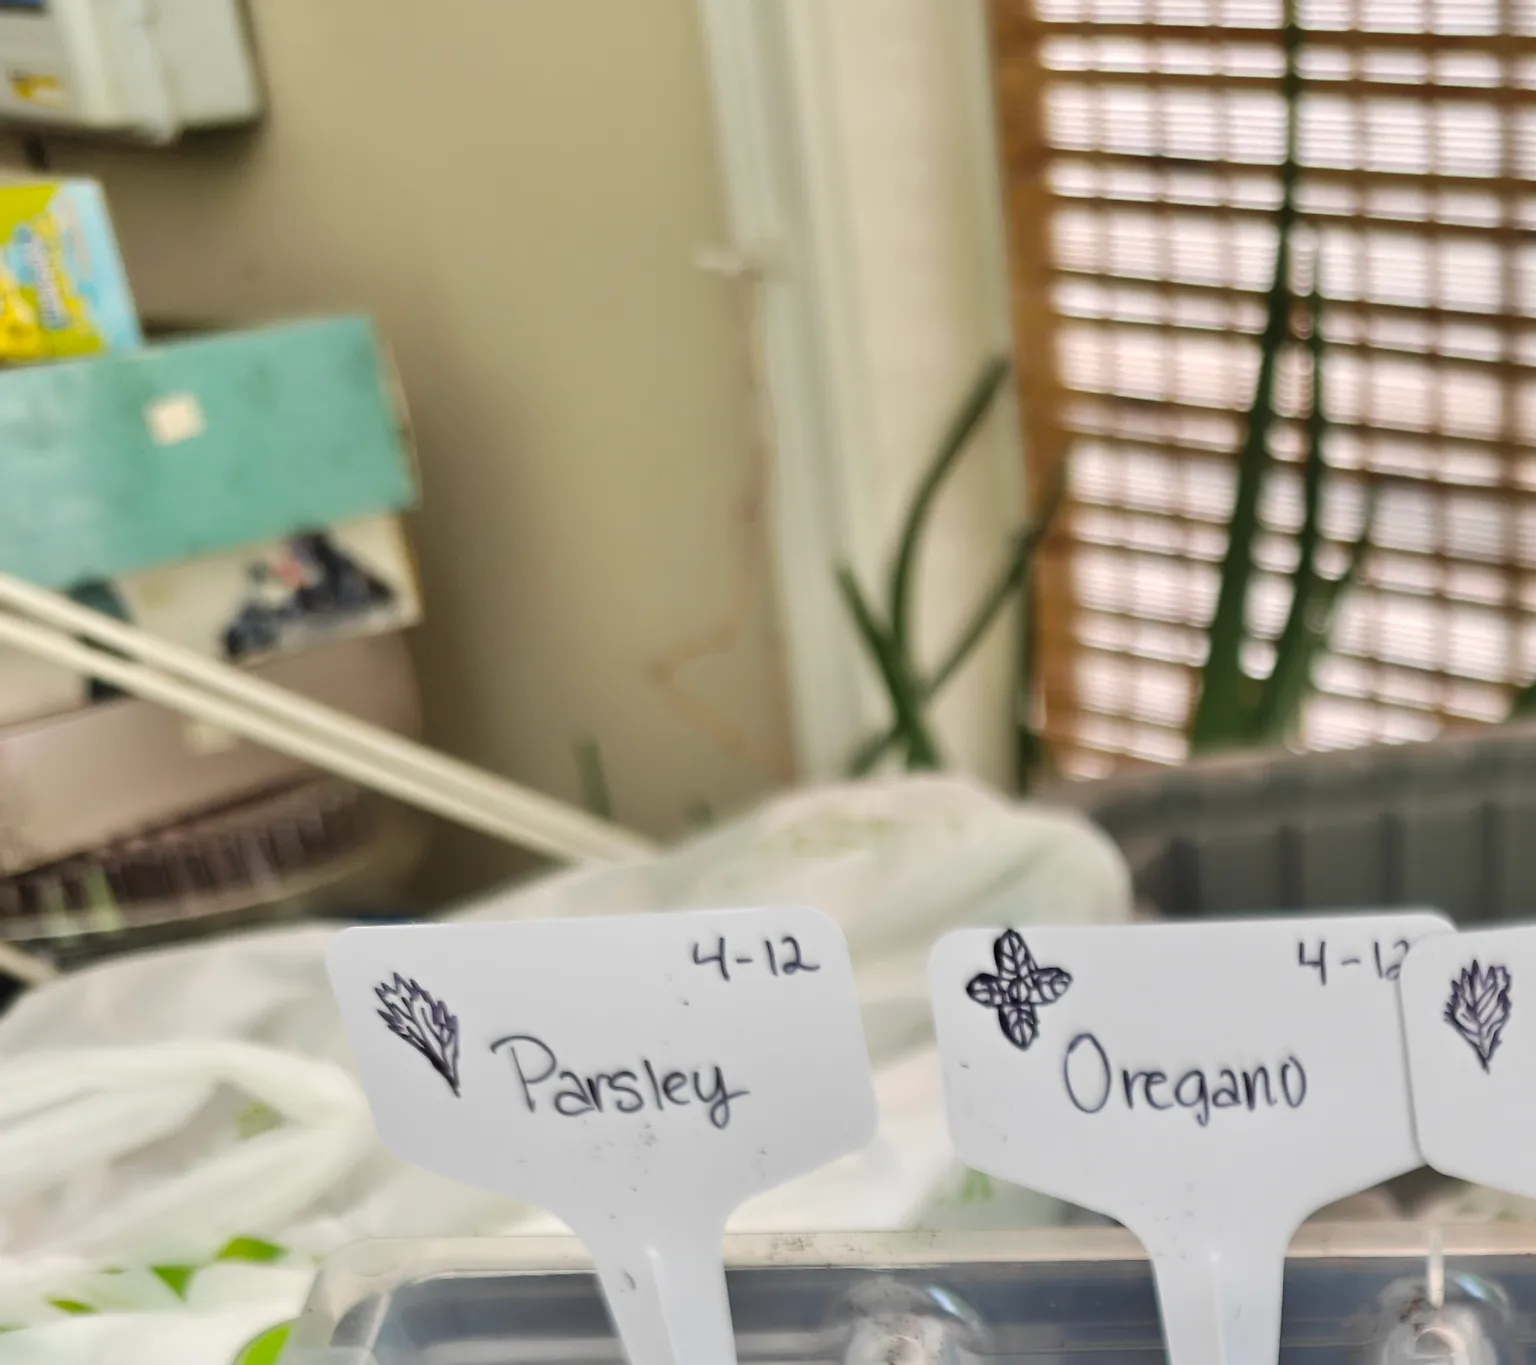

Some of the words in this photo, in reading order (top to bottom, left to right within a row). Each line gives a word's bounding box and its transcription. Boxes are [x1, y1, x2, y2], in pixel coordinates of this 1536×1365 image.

[691, 933, 821, 982] 4-12
[488, 1033, 751, 1130] Parsley
[1061, 1031, 1309, 1128] Oregano
